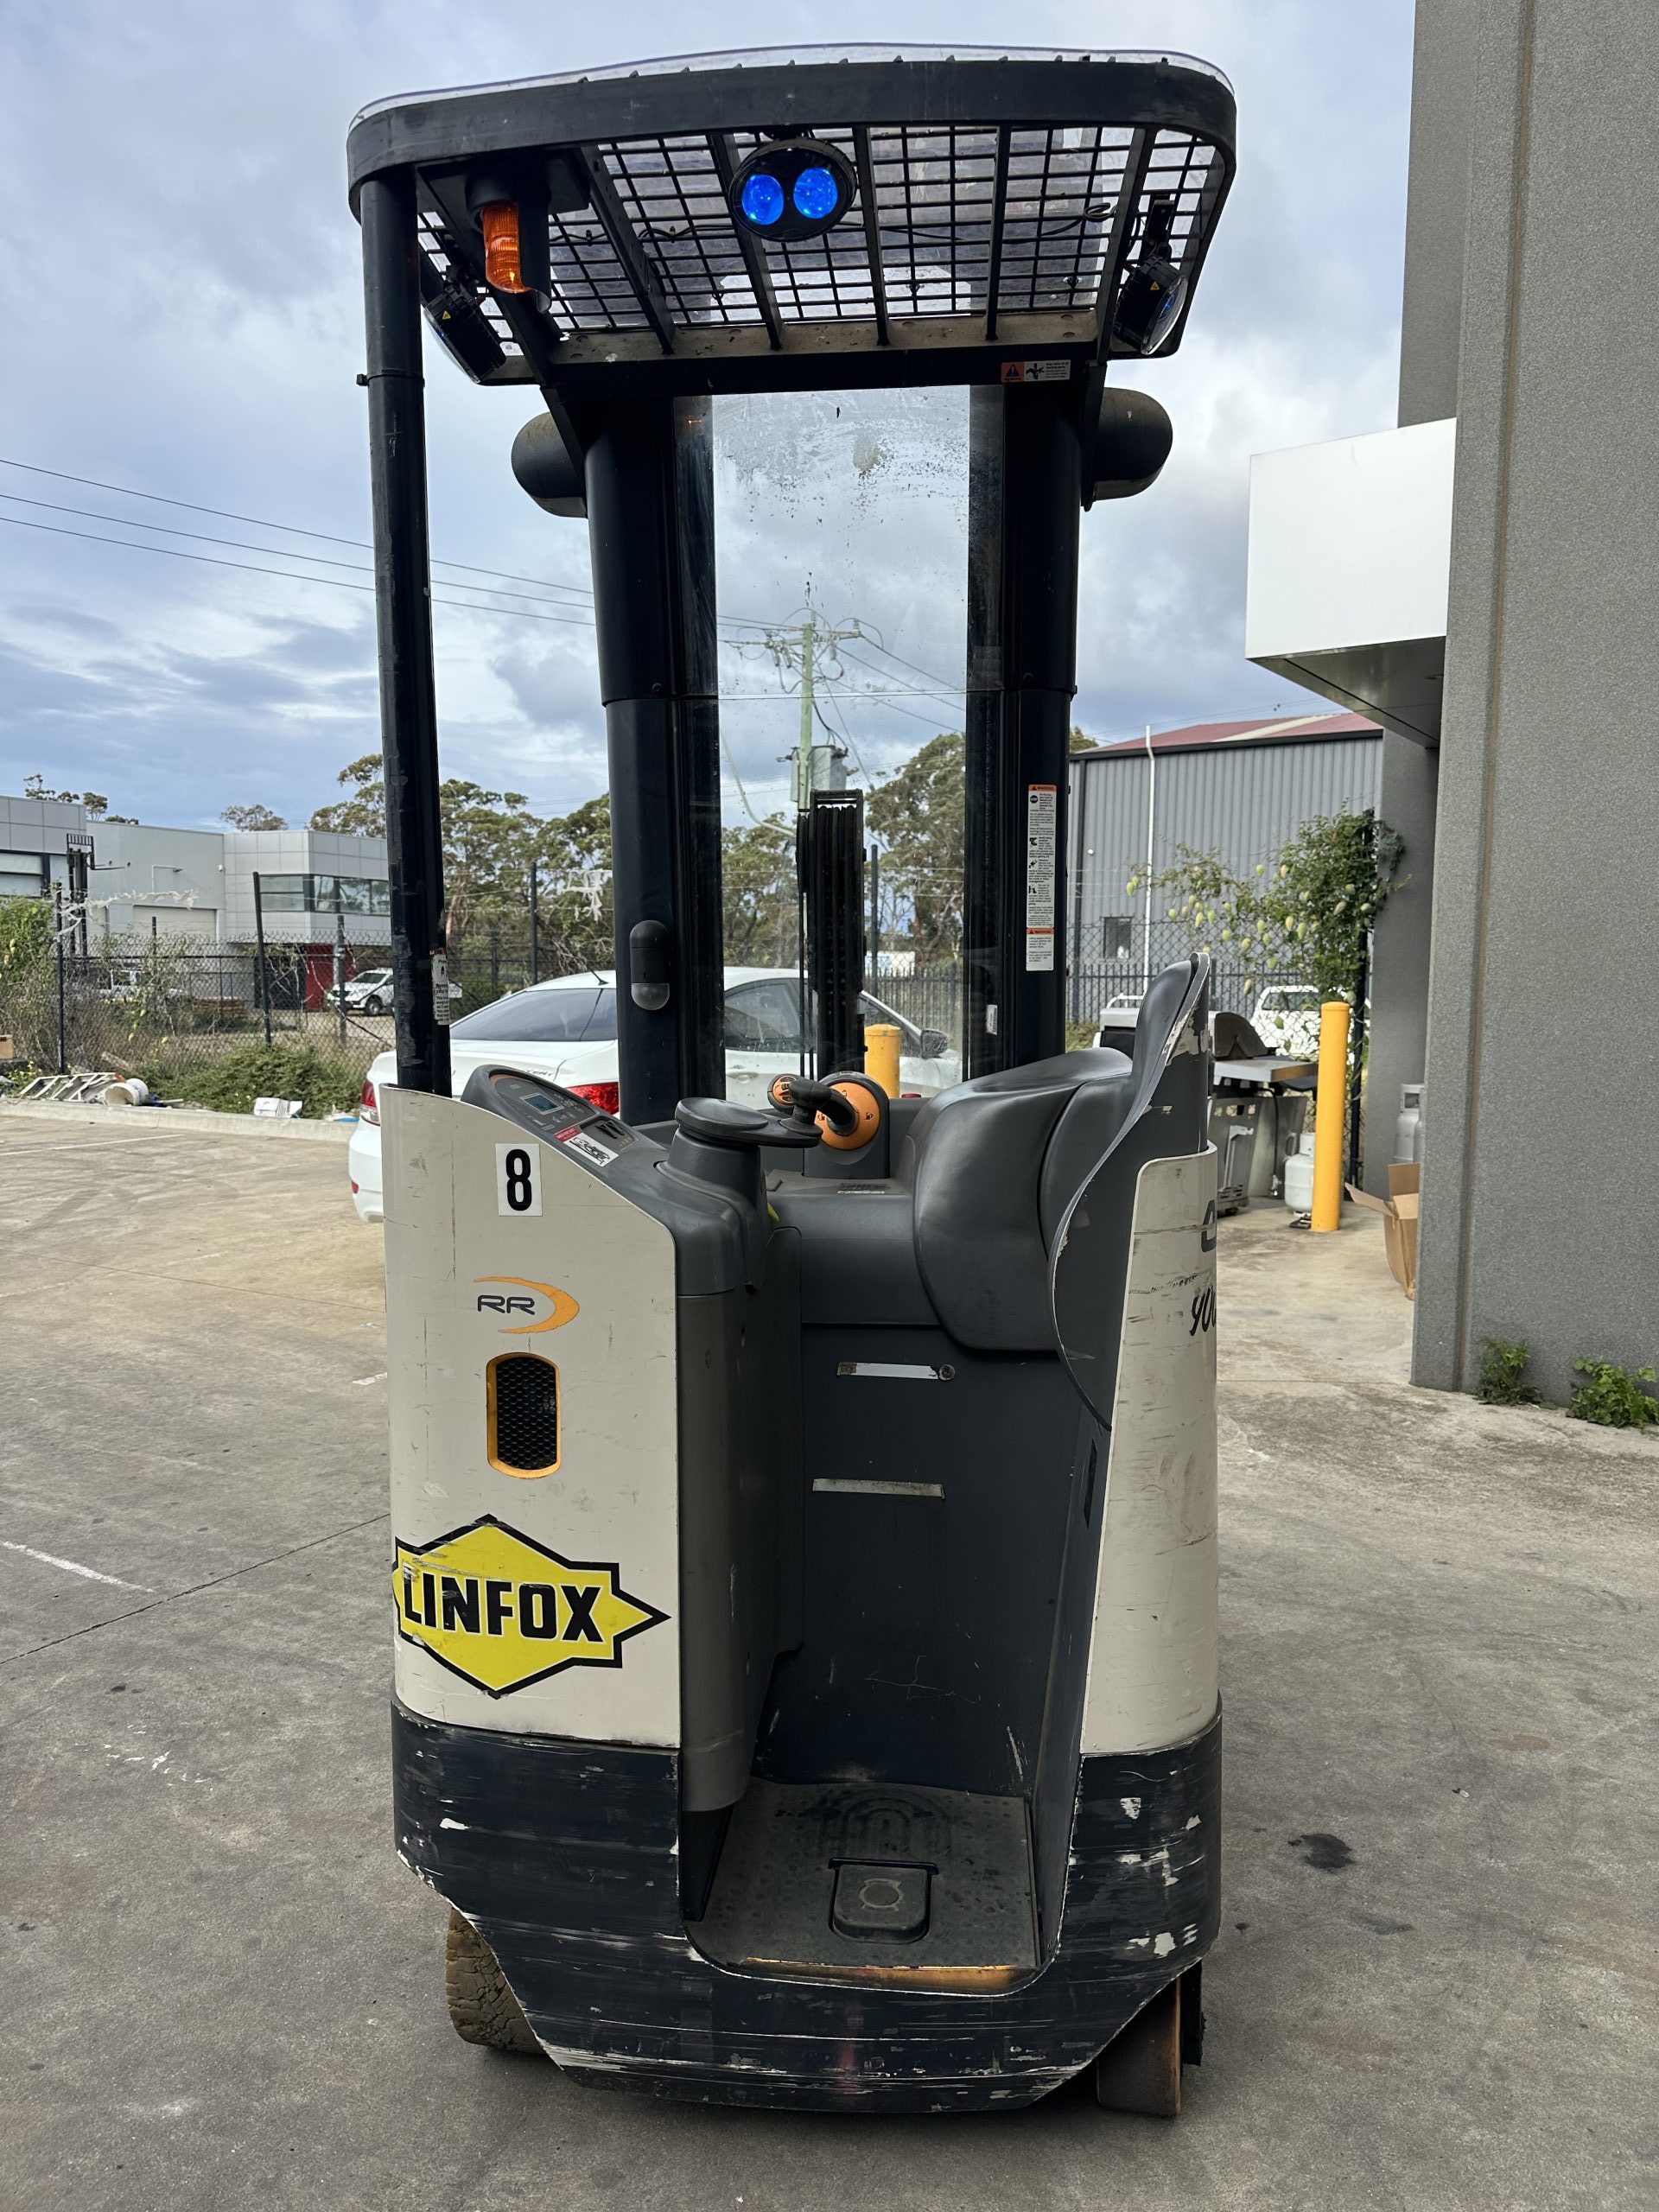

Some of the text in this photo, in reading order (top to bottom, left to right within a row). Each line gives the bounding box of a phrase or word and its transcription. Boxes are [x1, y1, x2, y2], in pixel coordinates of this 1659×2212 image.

[505, 1148, 532, 1211] 8
[477, 1294, 535, 1315] RR
[402, 1562, 604, 1643] LINFOX
